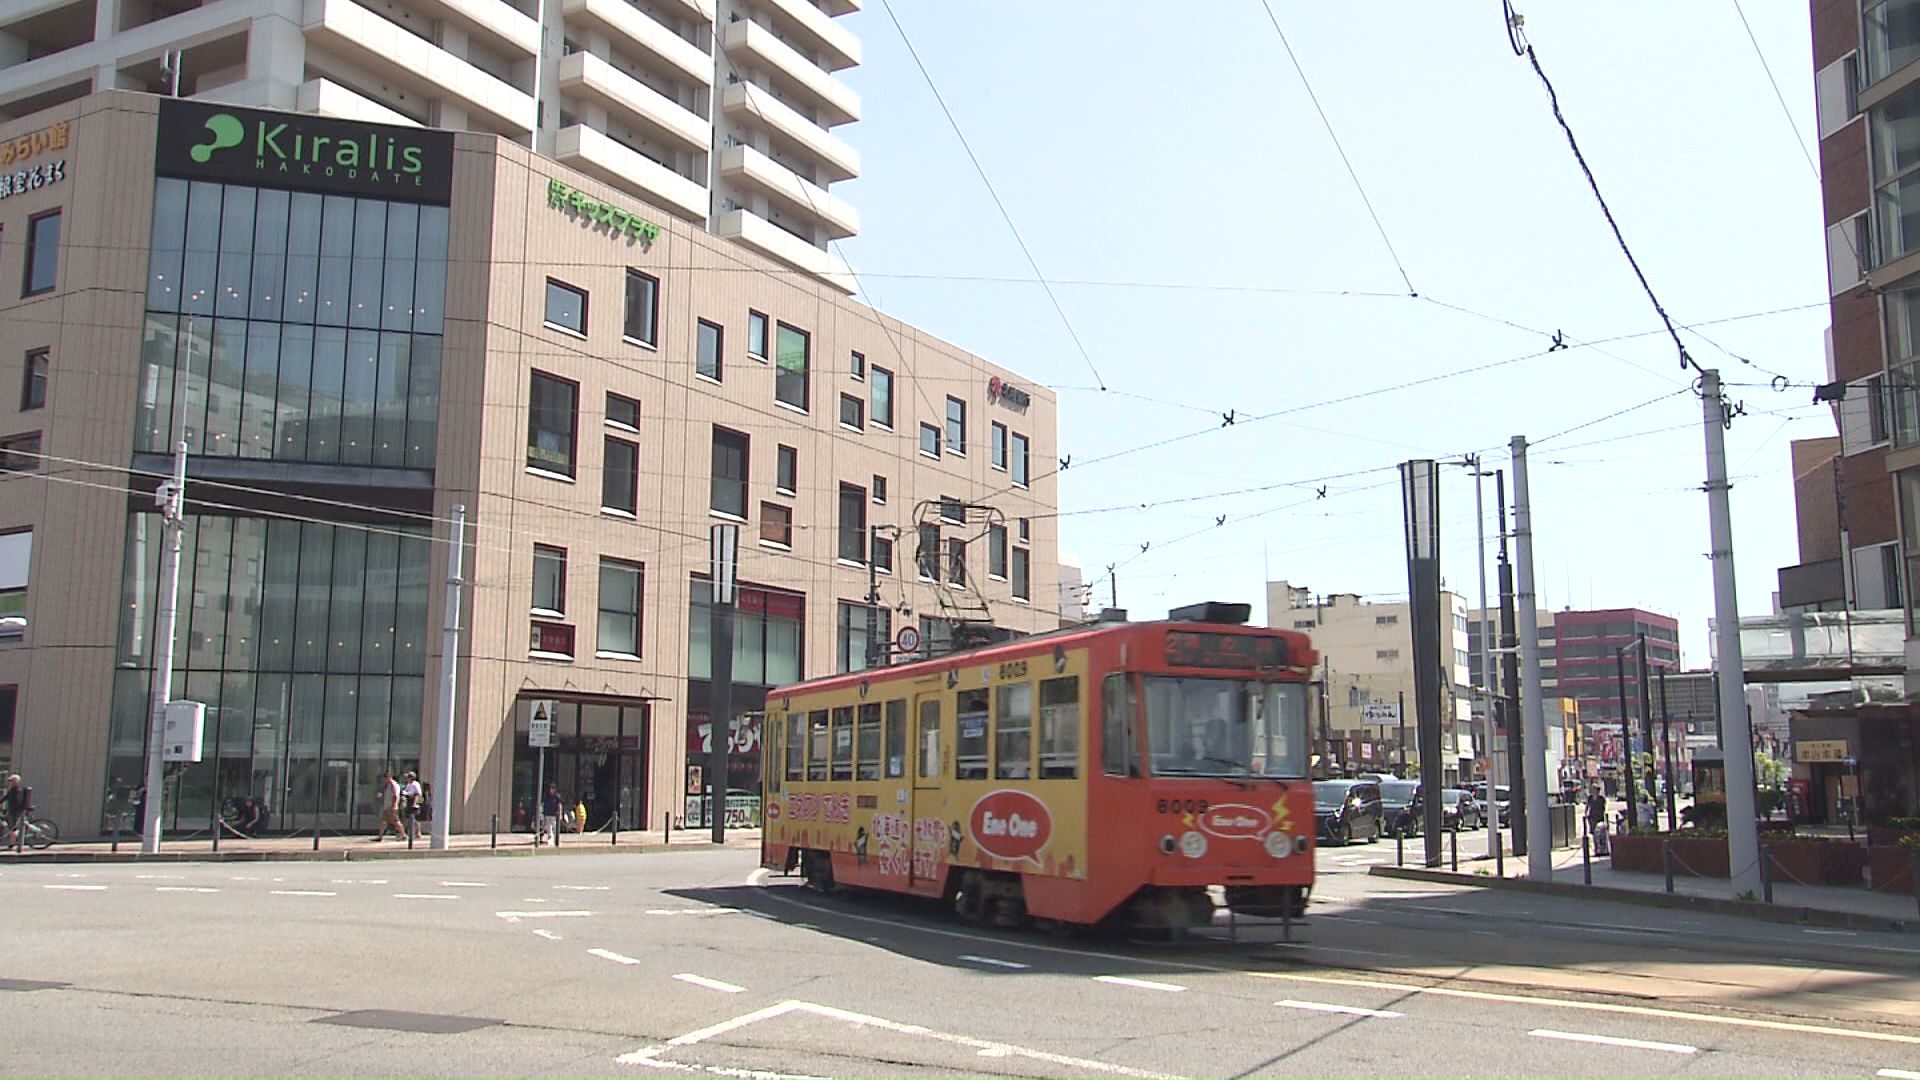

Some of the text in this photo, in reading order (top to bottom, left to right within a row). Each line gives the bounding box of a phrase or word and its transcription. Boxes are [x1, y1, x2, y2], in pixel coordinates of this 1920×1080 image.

[257, 121, 422, 173] Kiralis
[256, 158, 422, 186] HAKODATE
[902, 633, 915, 646] 40
